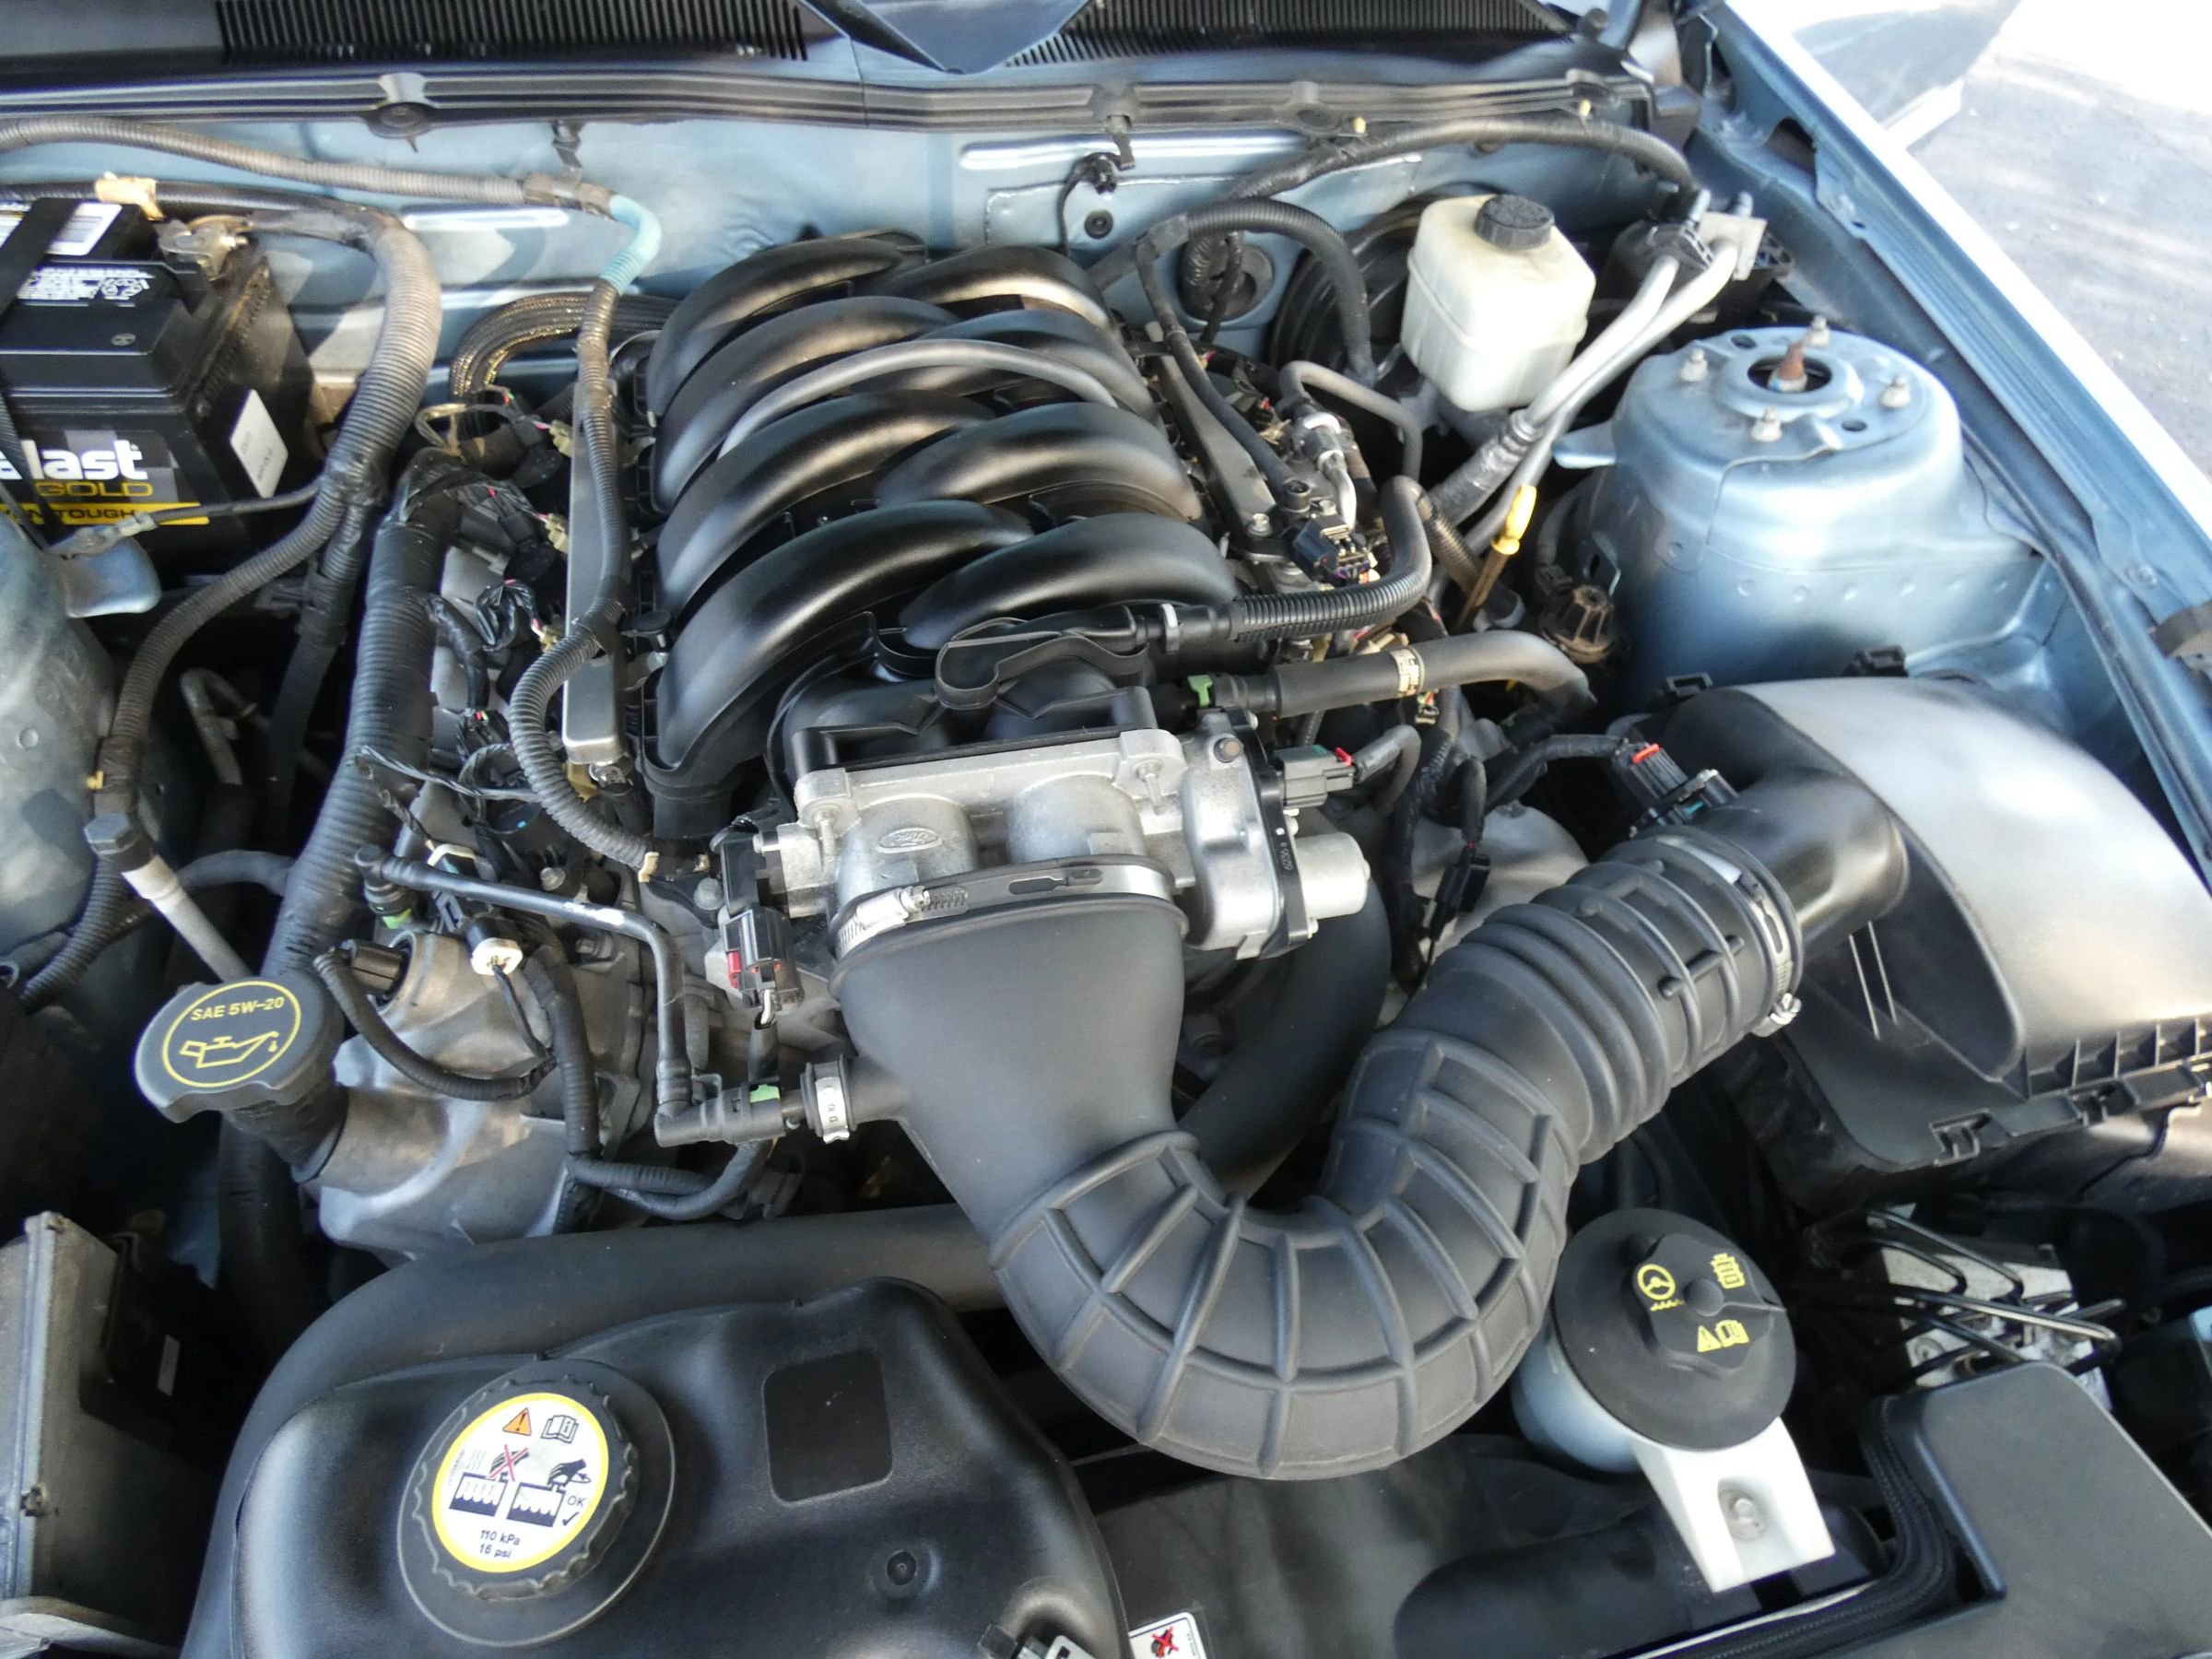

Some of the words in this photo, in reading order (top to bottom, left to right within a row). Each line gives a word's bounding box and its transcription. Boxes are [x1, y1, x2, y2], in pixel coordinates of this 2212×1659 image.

[34, 481, 154, 497] GOLD
[191, 1004, 226, 1021] SAE
[229, 996, 286, 1016] 5W-20
[567, 1495, 586, 1508] OK
[480, 1529, 498, 1541] 110
[500, 1532, 521, 1546] kPa
[479, 1543, 492, 1555] 16
[494, 1548, 512, 1559] psi
